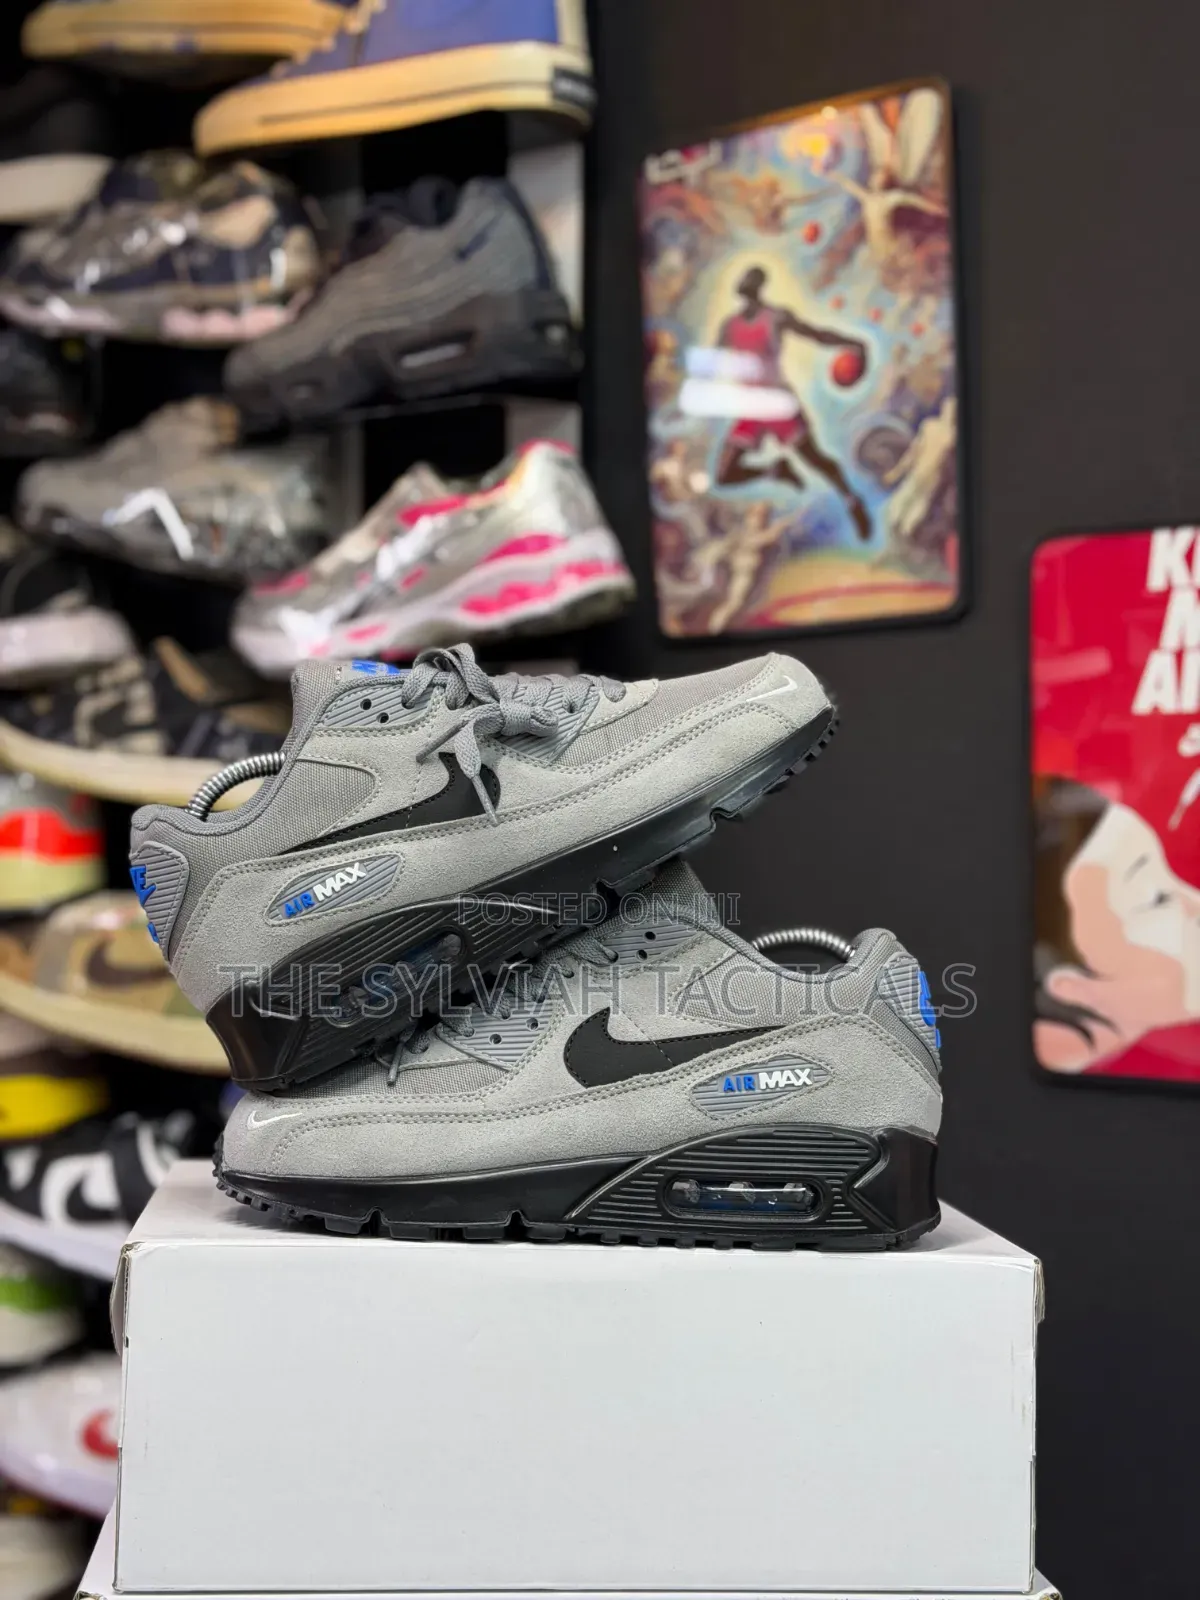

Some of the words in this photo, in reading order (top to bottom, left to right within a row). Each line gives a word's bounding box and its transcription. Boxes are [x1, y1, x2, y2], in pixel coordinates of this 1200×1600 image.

[284, 890, 316, 918] AIR
[312, 862, 367, 902] MAX
[723, 1074, 756, 1093] AIR
[758, 1067, 813, 1091] MAX
